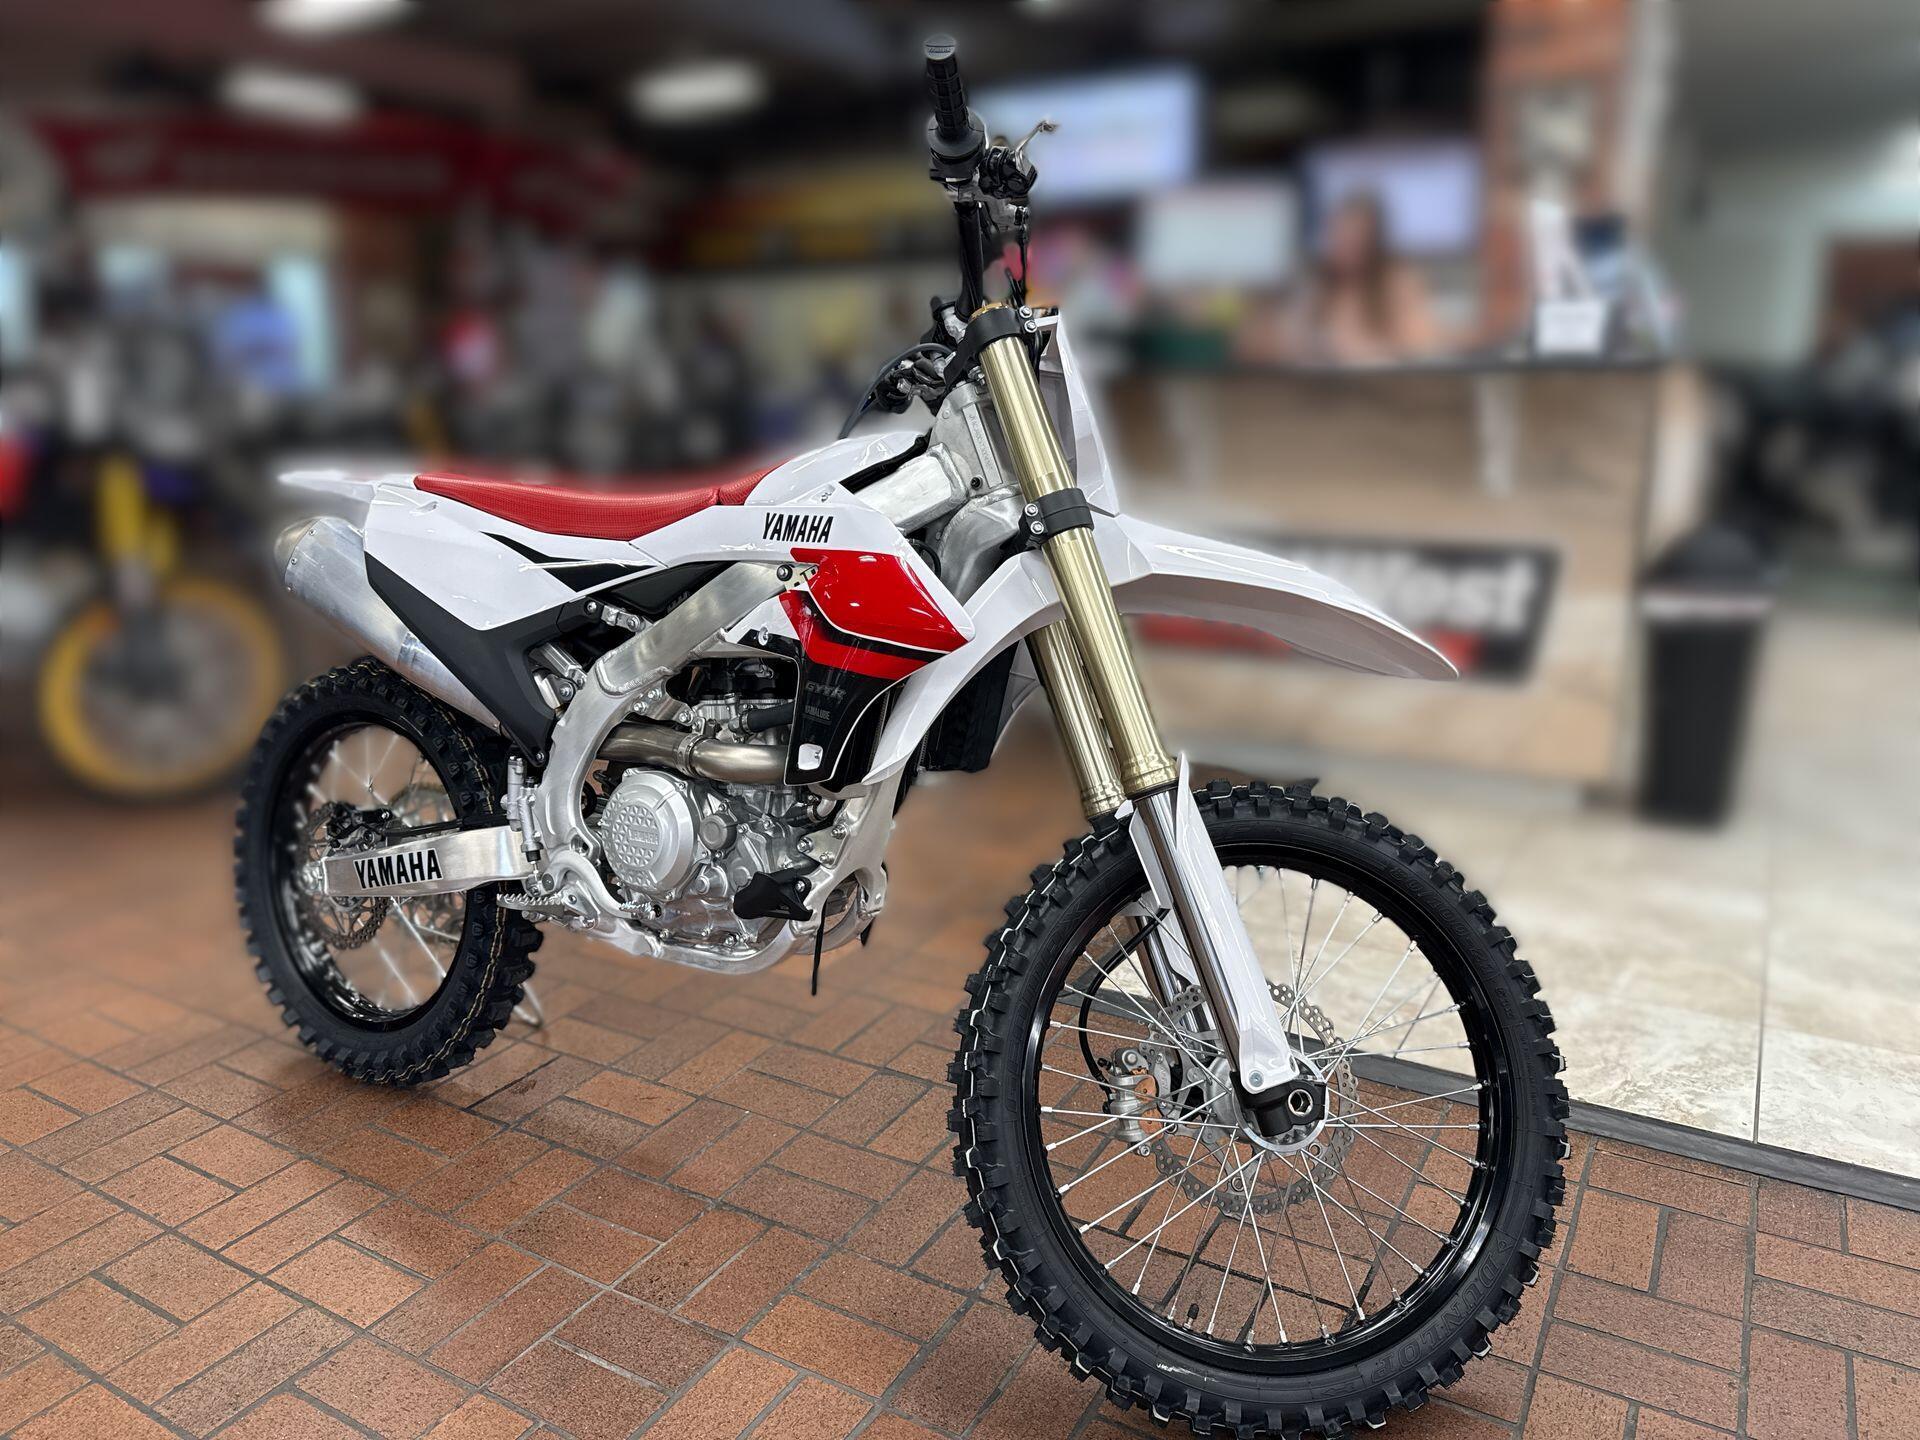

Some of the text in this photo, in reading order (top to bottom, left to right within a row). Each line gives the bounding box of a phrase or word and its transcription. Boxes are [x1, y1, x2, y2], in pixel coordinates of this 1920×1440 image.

[763, 512, 834, 543] YAMAHA
[355, 850, 442, 888] YAMAHA
[1370, 1252, 1502, 1383] DUNLOP
